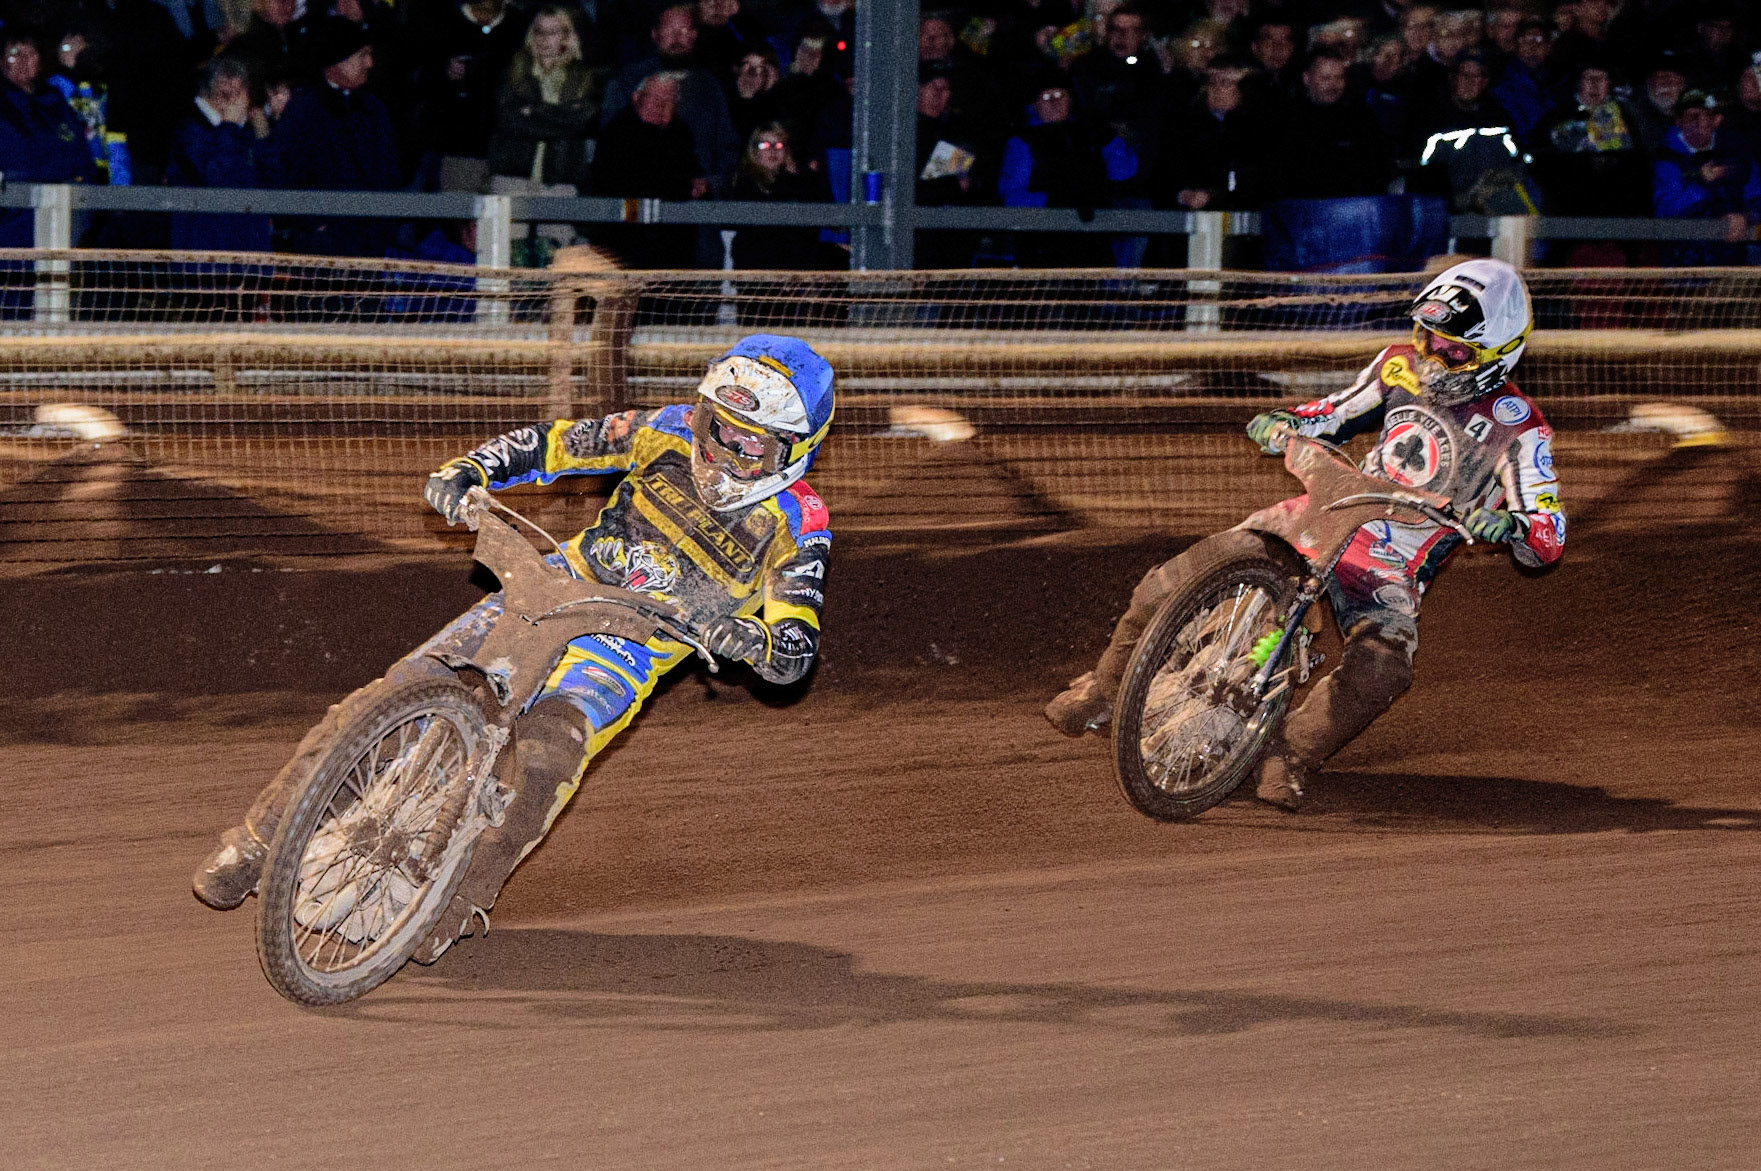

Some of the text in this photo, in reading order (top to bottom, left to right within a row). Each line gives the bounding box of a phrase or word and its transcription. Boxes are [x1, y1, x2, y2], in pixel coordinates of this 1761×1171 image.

[1503, 400, 1522, 417] ATPI
[1420, 416, 1440, 435] VUE
[1438, 437, 1451, 467] ACES
[1469, 421, 1487, 438] 4
[688, 508, 752, 564] PLANT
